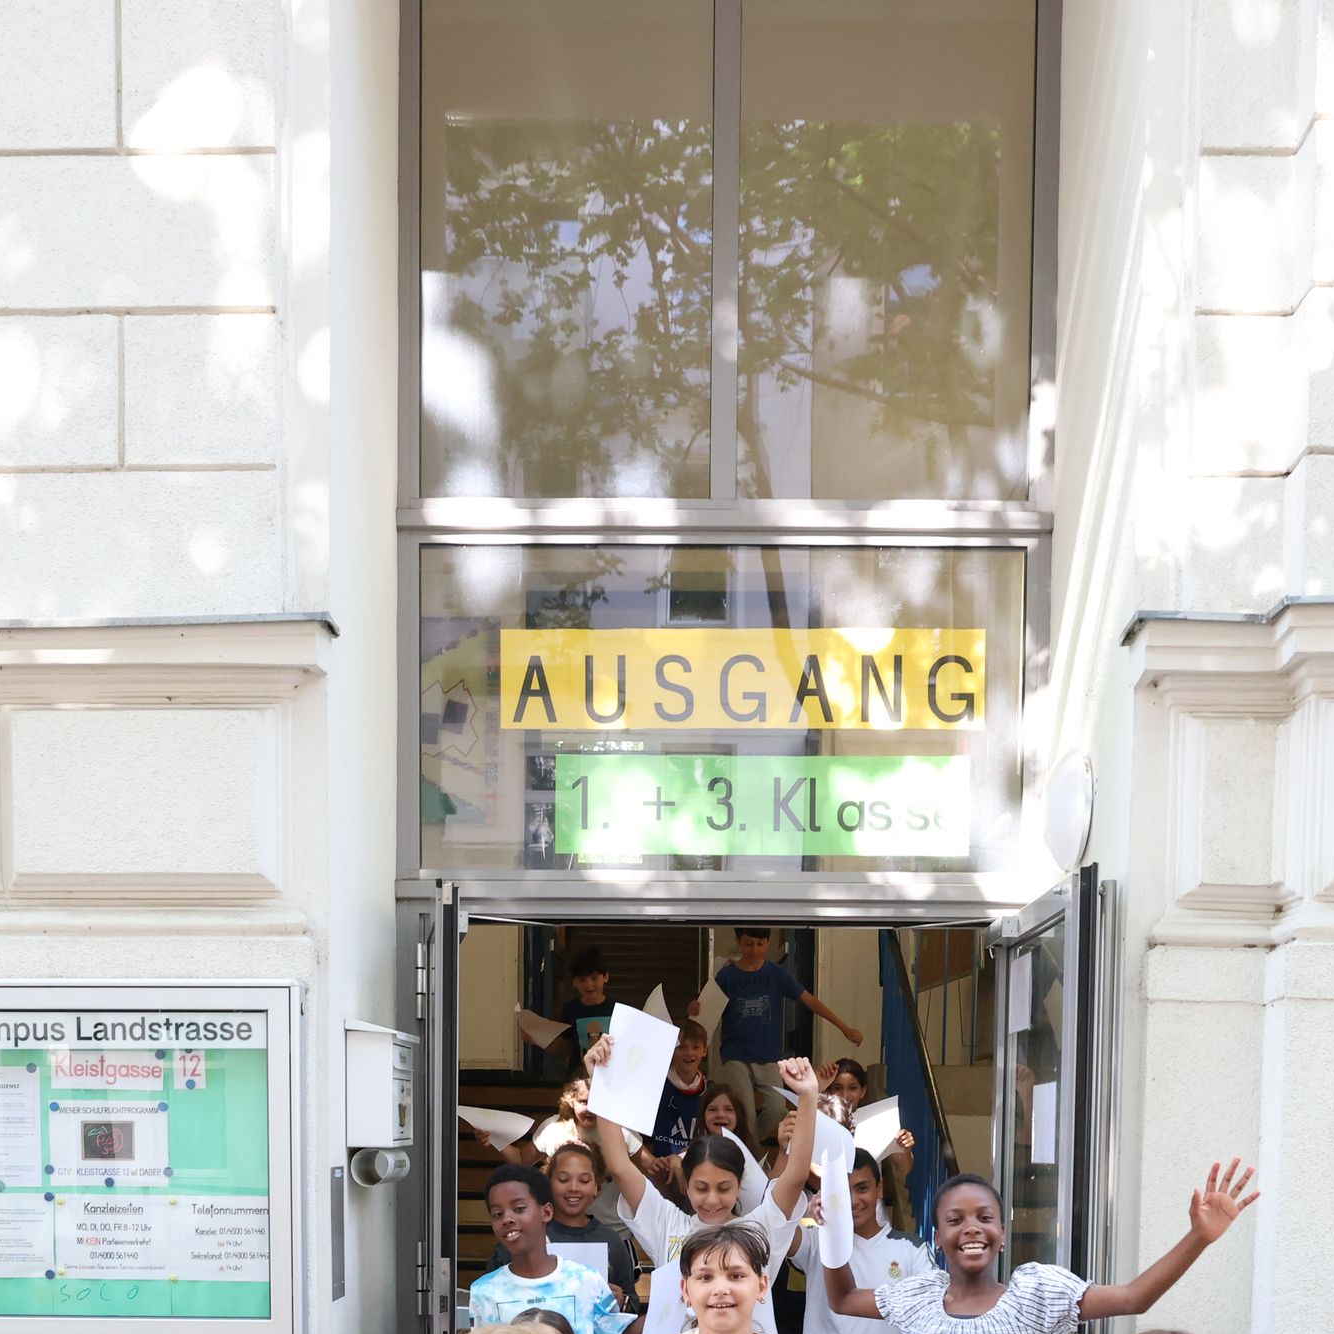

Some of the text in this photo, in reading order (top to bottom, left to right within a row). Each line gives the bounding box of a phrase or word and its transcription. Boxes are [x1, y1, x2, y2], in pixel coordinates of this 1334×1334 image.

[512, 653, 976, 724] AUSGANG
[571, 776, 610, 832] 1.
[643, 786, 676, 822] +
[706, 776, 747, 832] 3.
[76, 1016, 253, 1042] Landstrasse
[55, 1055, 202, 1085] Kleistgasse 12
[59, 1106, 81, 1114] WIENER
[76, 1168, 123, 1176] KLEISTGASSE
[83, 1202, 144, 1214] Kanzleizeiten
[191, 1203, 269, 1218] Telefonnummern
[76, 1223, 88, 1232] MO,
[100, 1223, 112, 1232] DO,
[140, 1223, 152, 1231] Uhr
[85, 1237, 101, 1246] KEIN
